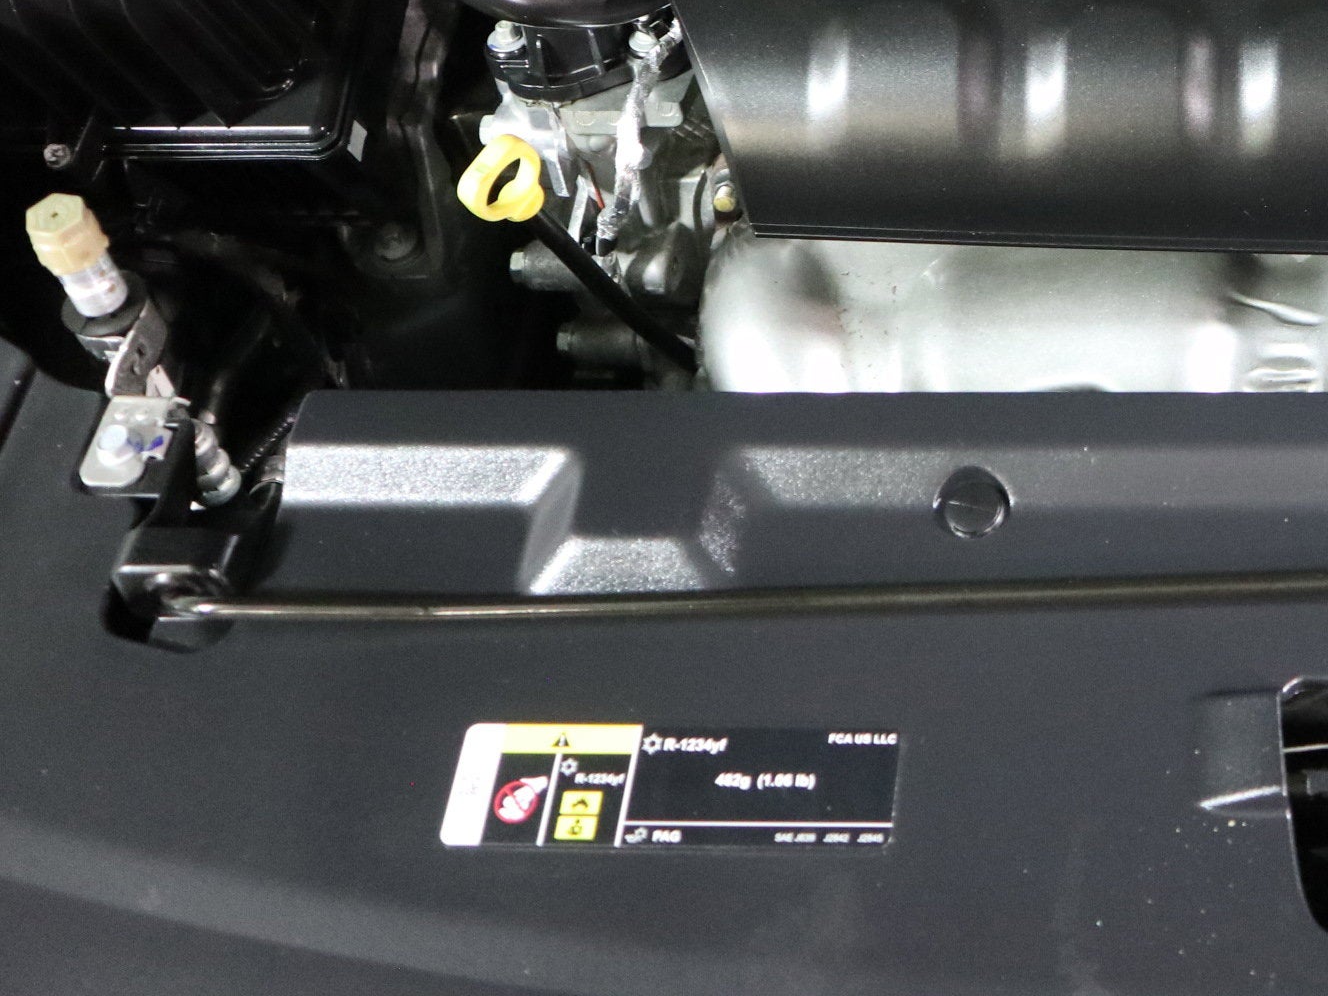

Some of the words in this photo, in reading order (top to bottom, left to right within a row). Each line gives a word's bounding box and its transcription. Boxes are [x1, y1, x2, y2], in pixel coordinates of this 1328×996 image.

[663, 736, 729, 755] R-1234yf
[827, 732, 852, 745] FCA
[854, 733, 873, 745] US
[873, 733, 898, 745] LLC
[574, 771, 626, 786] R-1234yf
[795, 772, 817, 790] lb)
[651, 829, 683, 843] PAG
